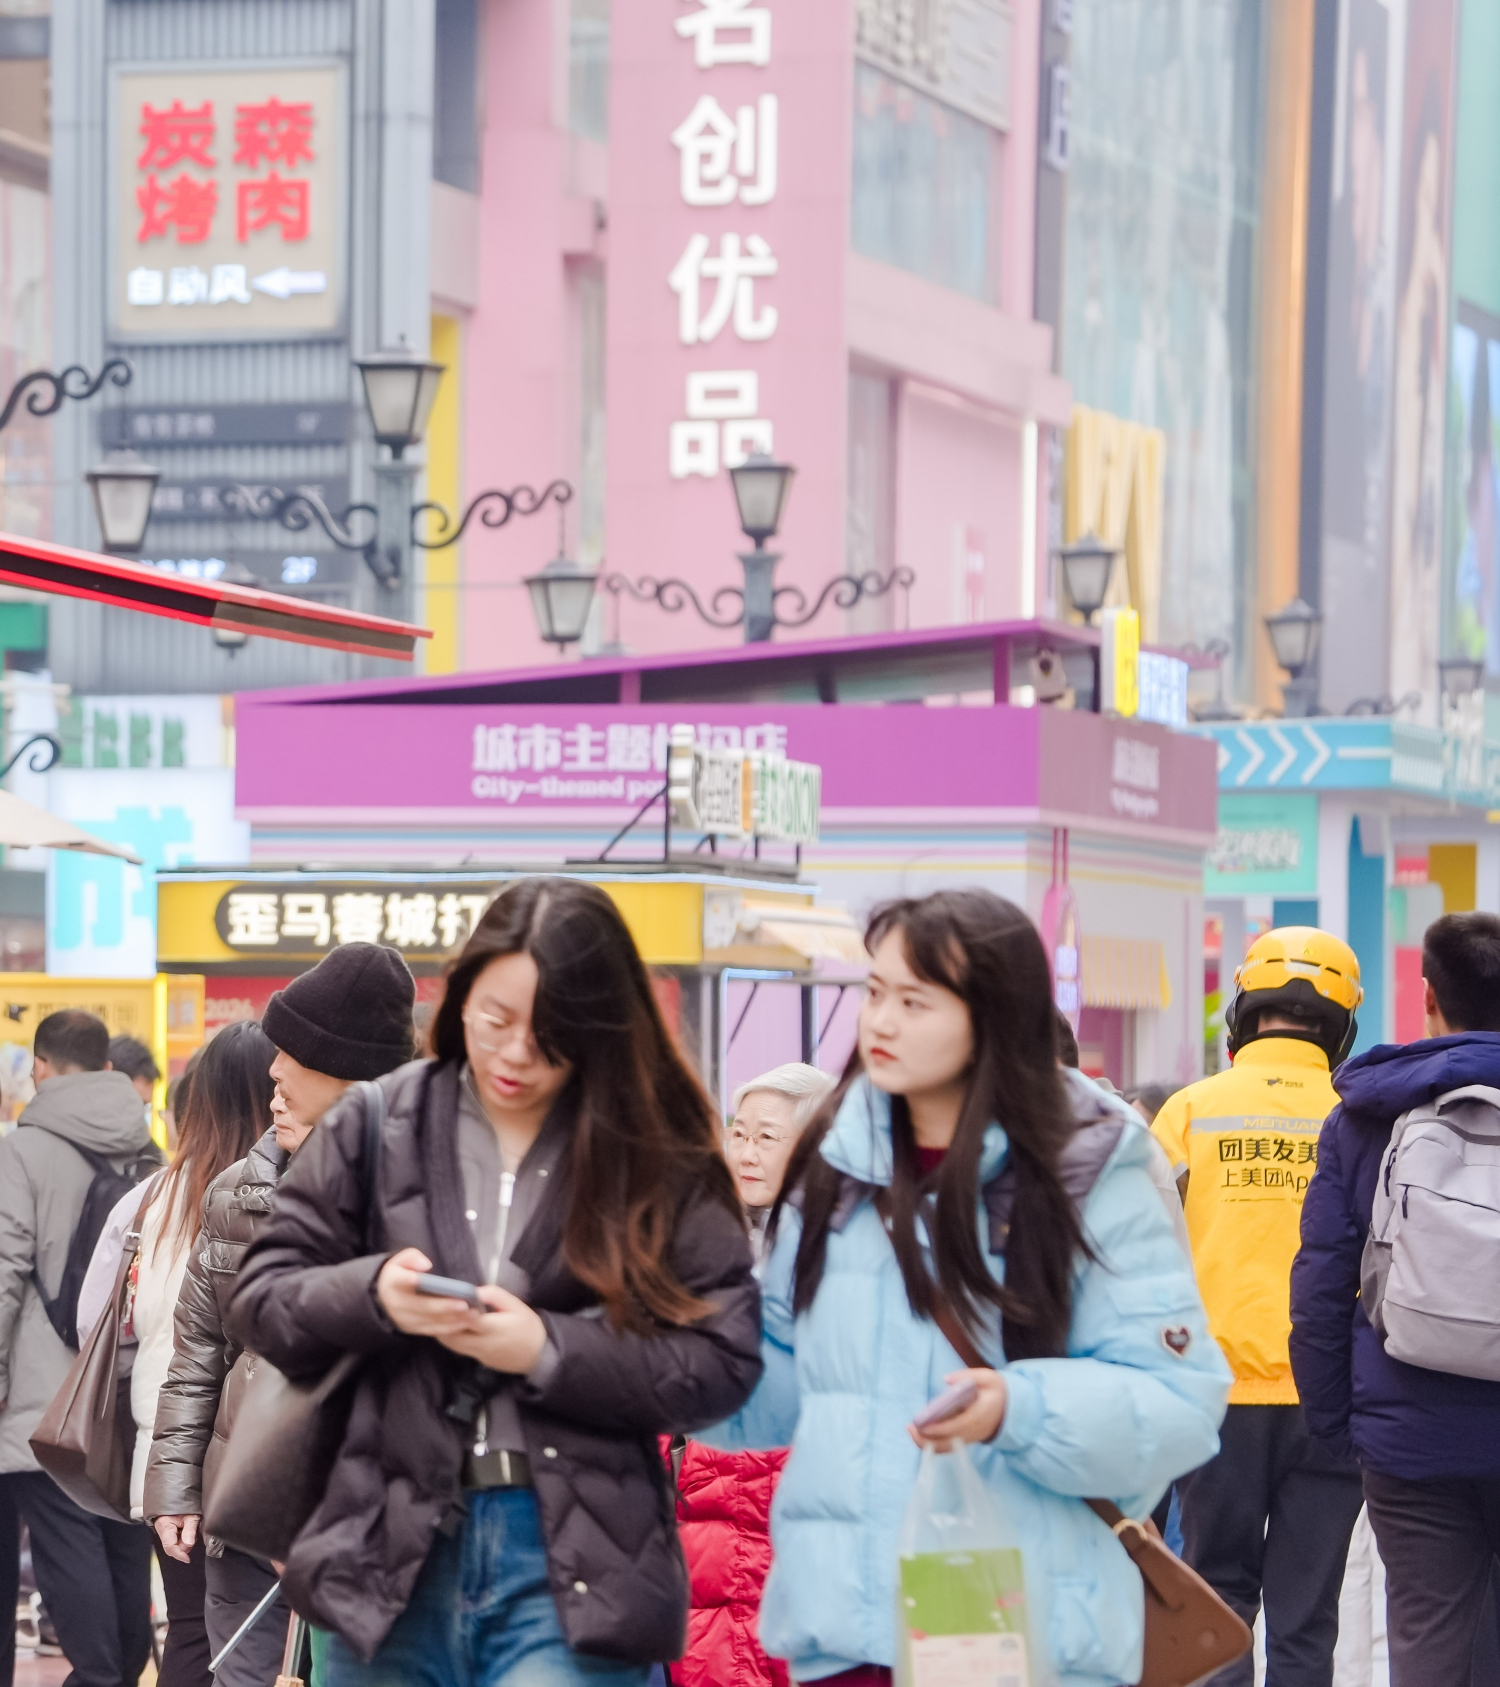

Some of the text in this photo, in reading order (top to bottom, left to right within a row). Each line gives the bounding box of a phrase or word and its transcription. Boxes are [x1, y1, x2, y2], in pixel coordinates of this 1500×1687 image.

[668, 0, 778, 479] 名创优品
[1243, 1117, 1323, 1131] MEITUAN
